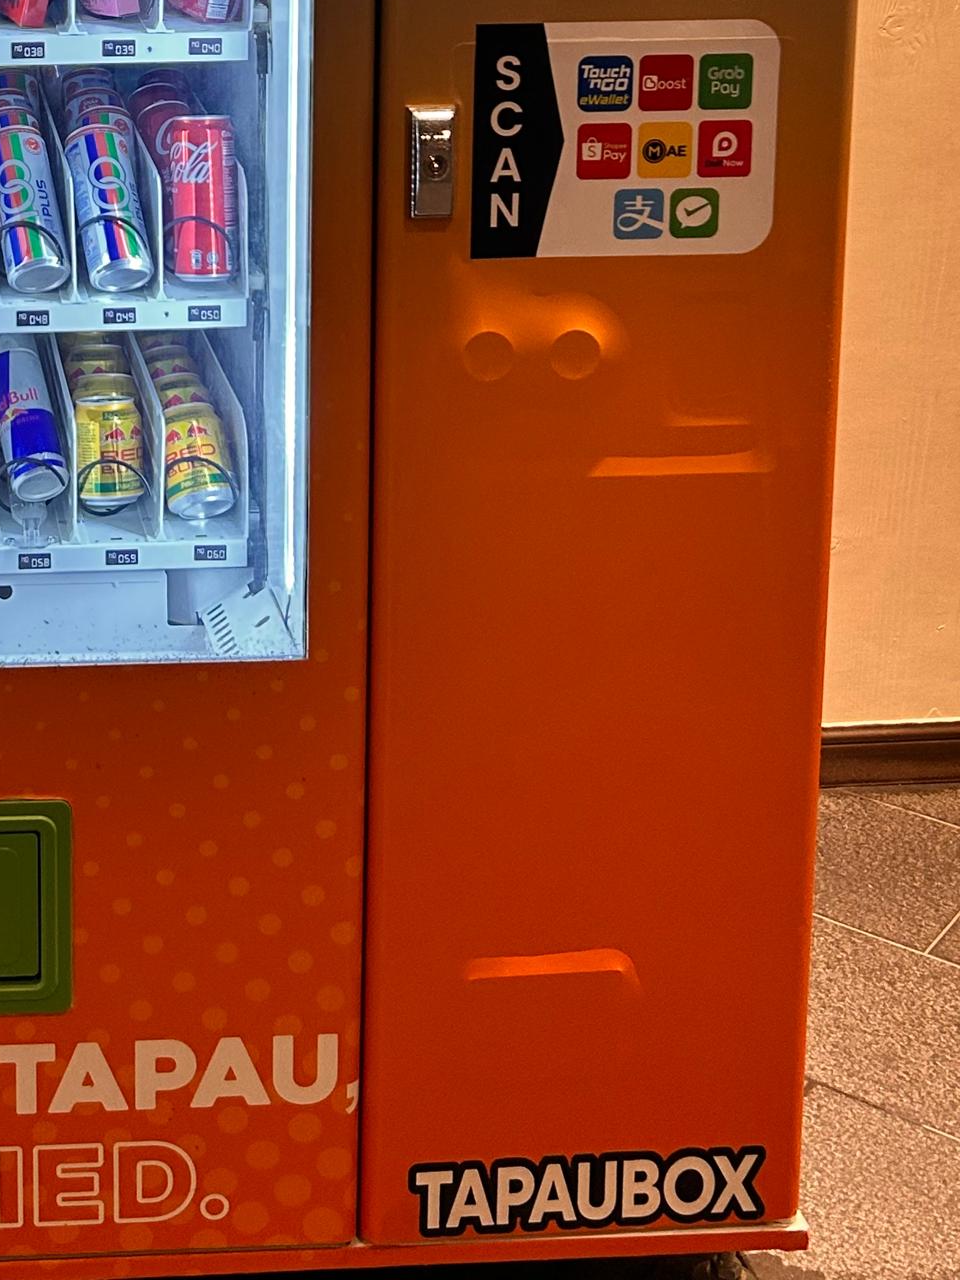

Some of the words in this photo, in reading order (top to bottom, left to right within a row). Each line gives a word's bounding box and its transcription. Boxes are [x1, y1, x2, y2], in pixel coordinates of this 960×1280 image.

[24, 47, 43, 57] 038
[116, 46, 134, 54] 039
[202, 44, 220, 53] 040
[581, 64, 631, 79] Touch
[707, 66, 745, 81] Grab
[711, 81, 741, 97] Pay
[580, 93, 630, 105] eWallet
[490, 55, 524, 228] SCAN
[603, 149, 627, 162] Pay
[37, 178, 53, 218] PLUS
[30, 315, 47, 324] 048
[116, 313, 134, 322] 049
[201, 310, 219, 319] 050
[11, 385, 40, 407] Bull
[165, 443, 217, 466] RED
[118, 554, 136, 563] 059
[207, 550, 225, 558] 060
[32, 558, 49, 567] 058
[415, 1153, 760, 1230] TAPAUBOX
